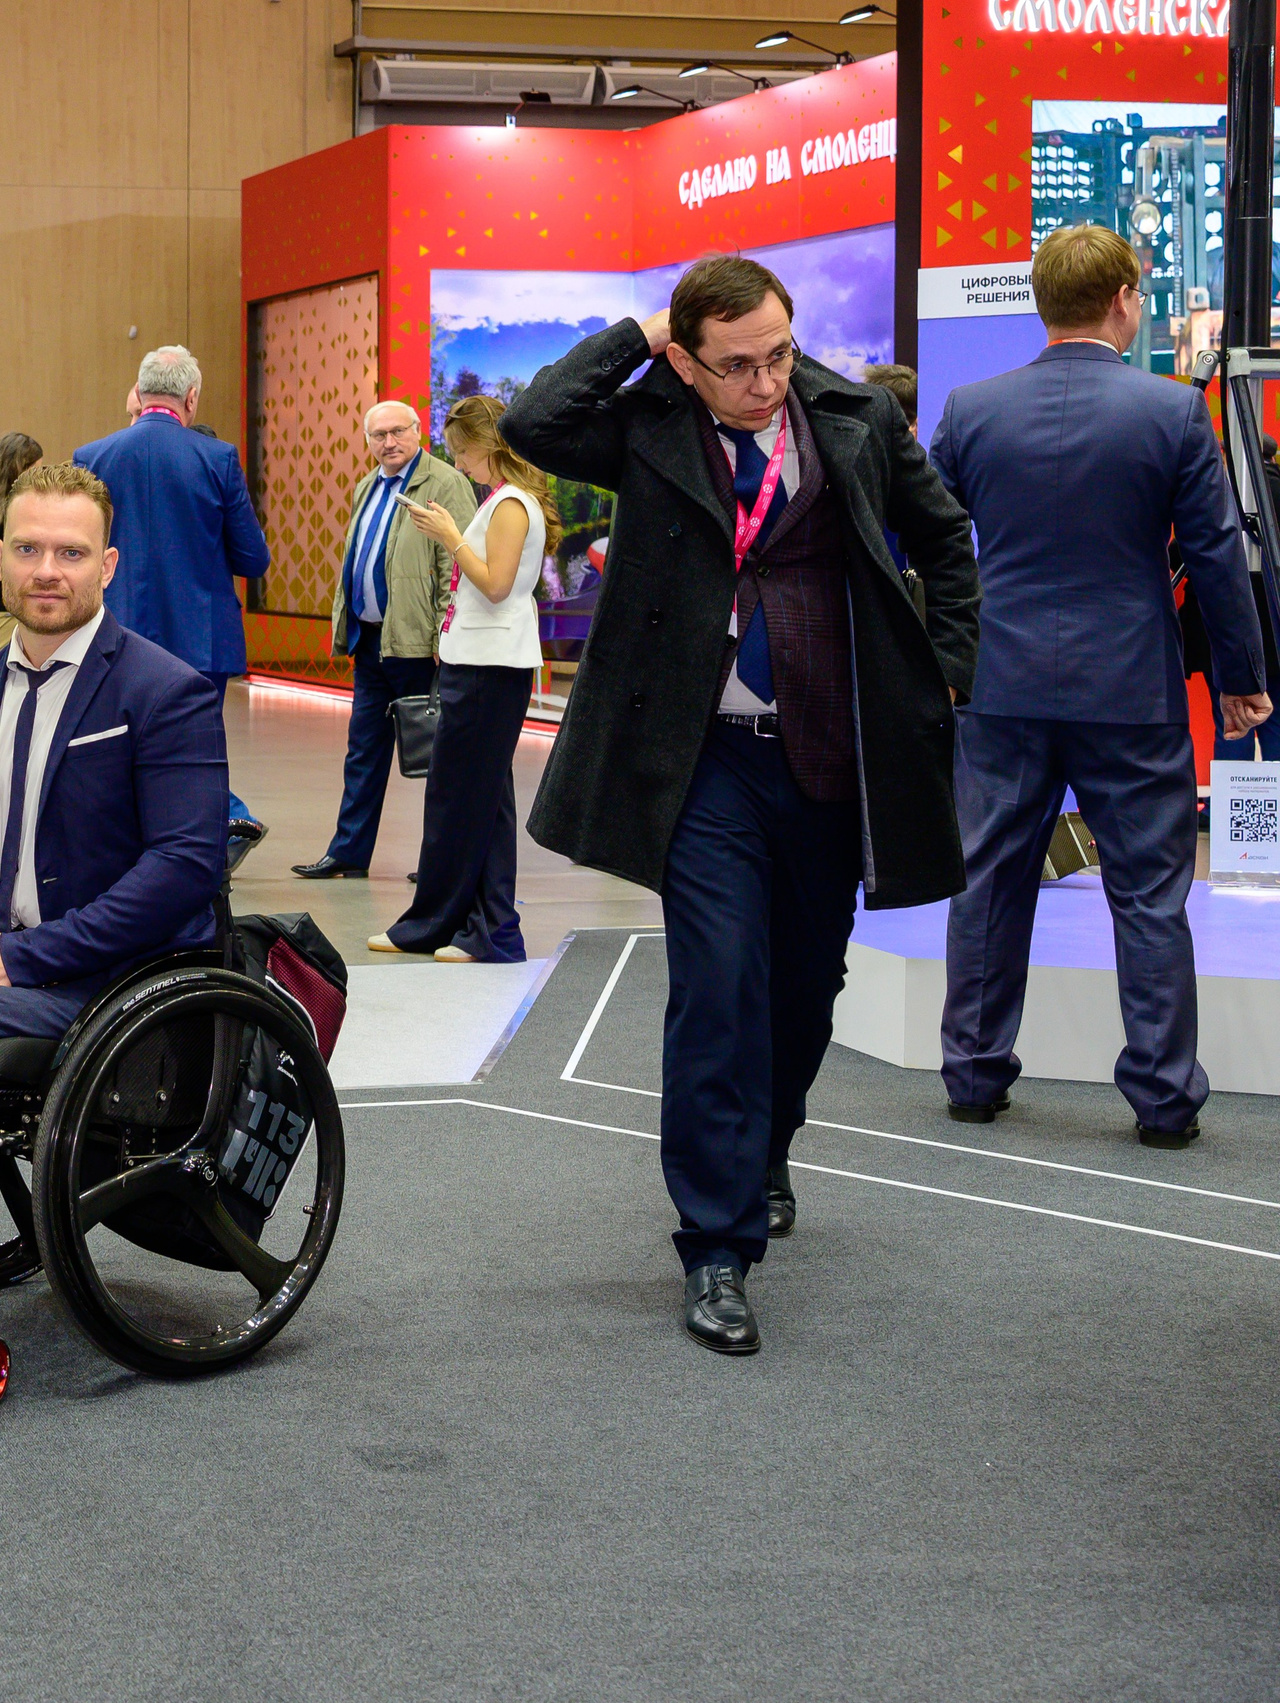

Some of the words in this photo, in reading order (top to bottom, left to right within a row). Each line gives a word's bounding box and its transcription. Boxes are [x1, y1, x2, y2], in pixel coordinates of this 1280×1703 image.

[678, 154, 757, 210] СДЕЛАНО
[766, 146, 792, 185] НА
[967, 290, 1030, 305] РЕШЕНИЯ
[1230, 775, 1277, 783] ОТСКАНИРУЙТЕ
[135, 977, 177, 1002] SENTINEL
[247, 1089, 306, 1155] 113
